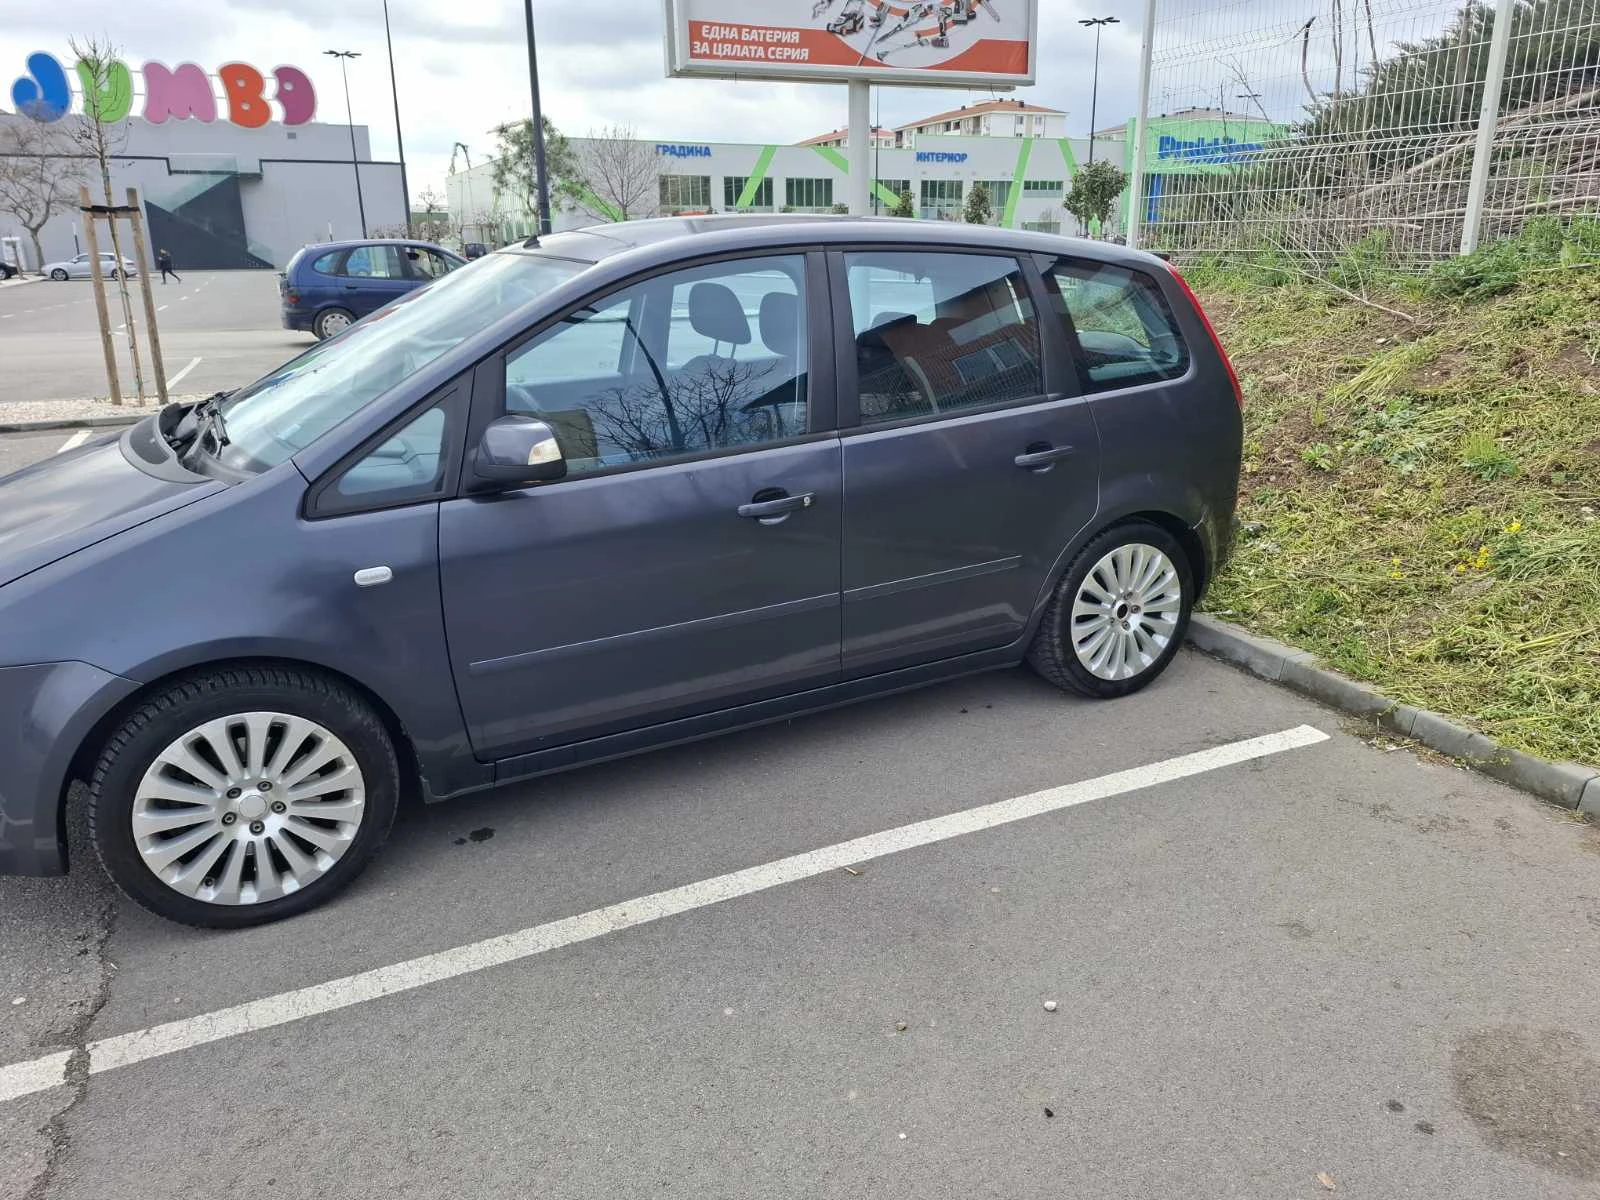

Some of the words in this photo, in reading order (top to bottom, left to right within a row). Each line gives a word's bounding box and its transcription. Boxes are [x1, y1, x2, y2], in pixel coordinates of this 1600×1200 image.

[702, 24, 739, 41] ЕДНА
[741, 27, 800, 43] БАТЕРИЯ
[692, 41, 710, 55] ЗА
[712, 42, 765, 57] ЦЯЛАТА
[767, 46, 809, 60] СЕРИЯ
[11, 50, 318, 129] JUMBO
[655, 144, 712, 158] ГРАДИНА
[916, 151, 968, 163] ИНТЕРИОР
